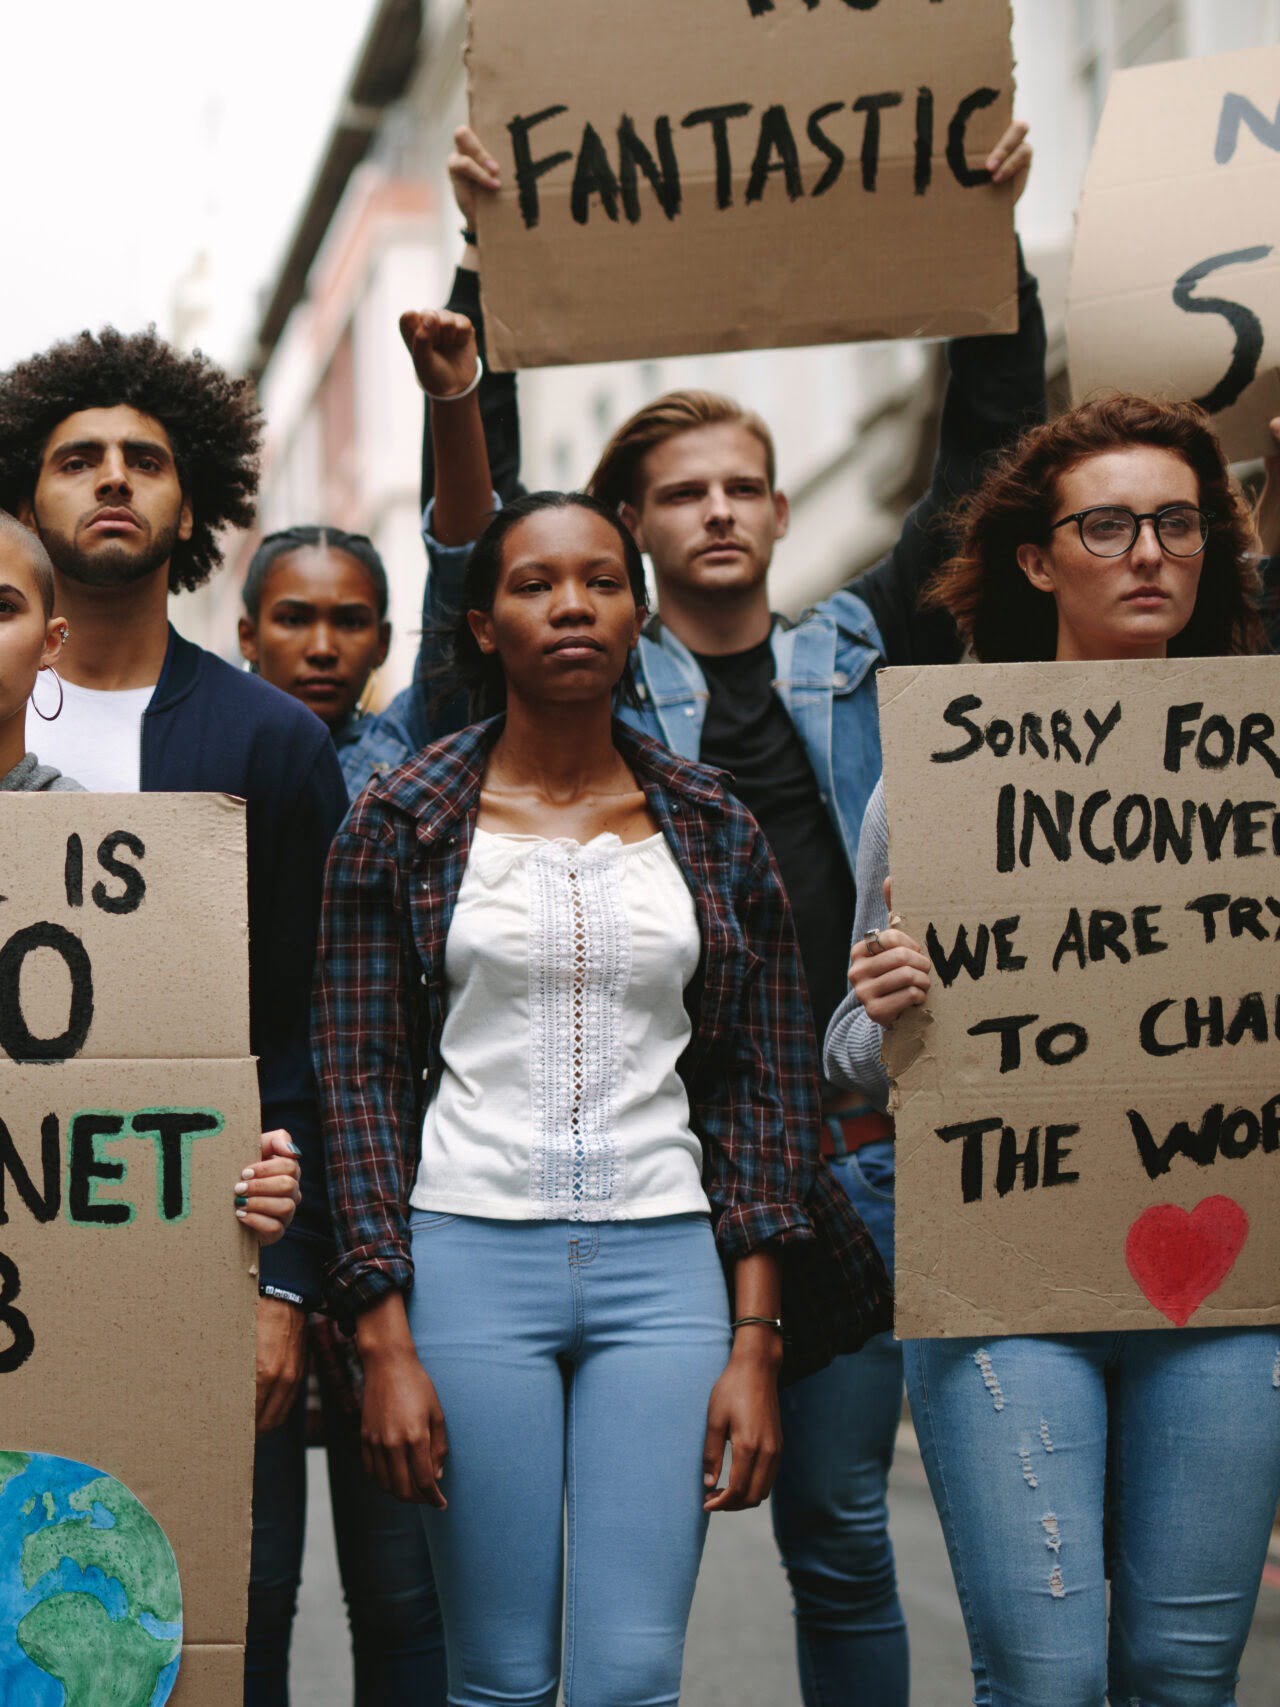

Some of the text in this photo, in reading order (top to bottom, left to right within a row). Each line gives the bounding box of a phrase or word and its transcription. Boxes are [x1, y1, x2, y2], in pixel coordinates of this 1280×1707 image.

[507, 87, 1001, 229] FANTASTIC
[931, 694, 1280, 779] SORRY FOR
[996, 783, 1280, 873] INCONVE
[64, 830, 147, 915] IS
[926, 914, 1028, 988] WE
[1053, 905, 1168, 973] ARE
[967, 991, 1280, 1074] TO CHA
[934, 1116, 1081, 1203] THE
